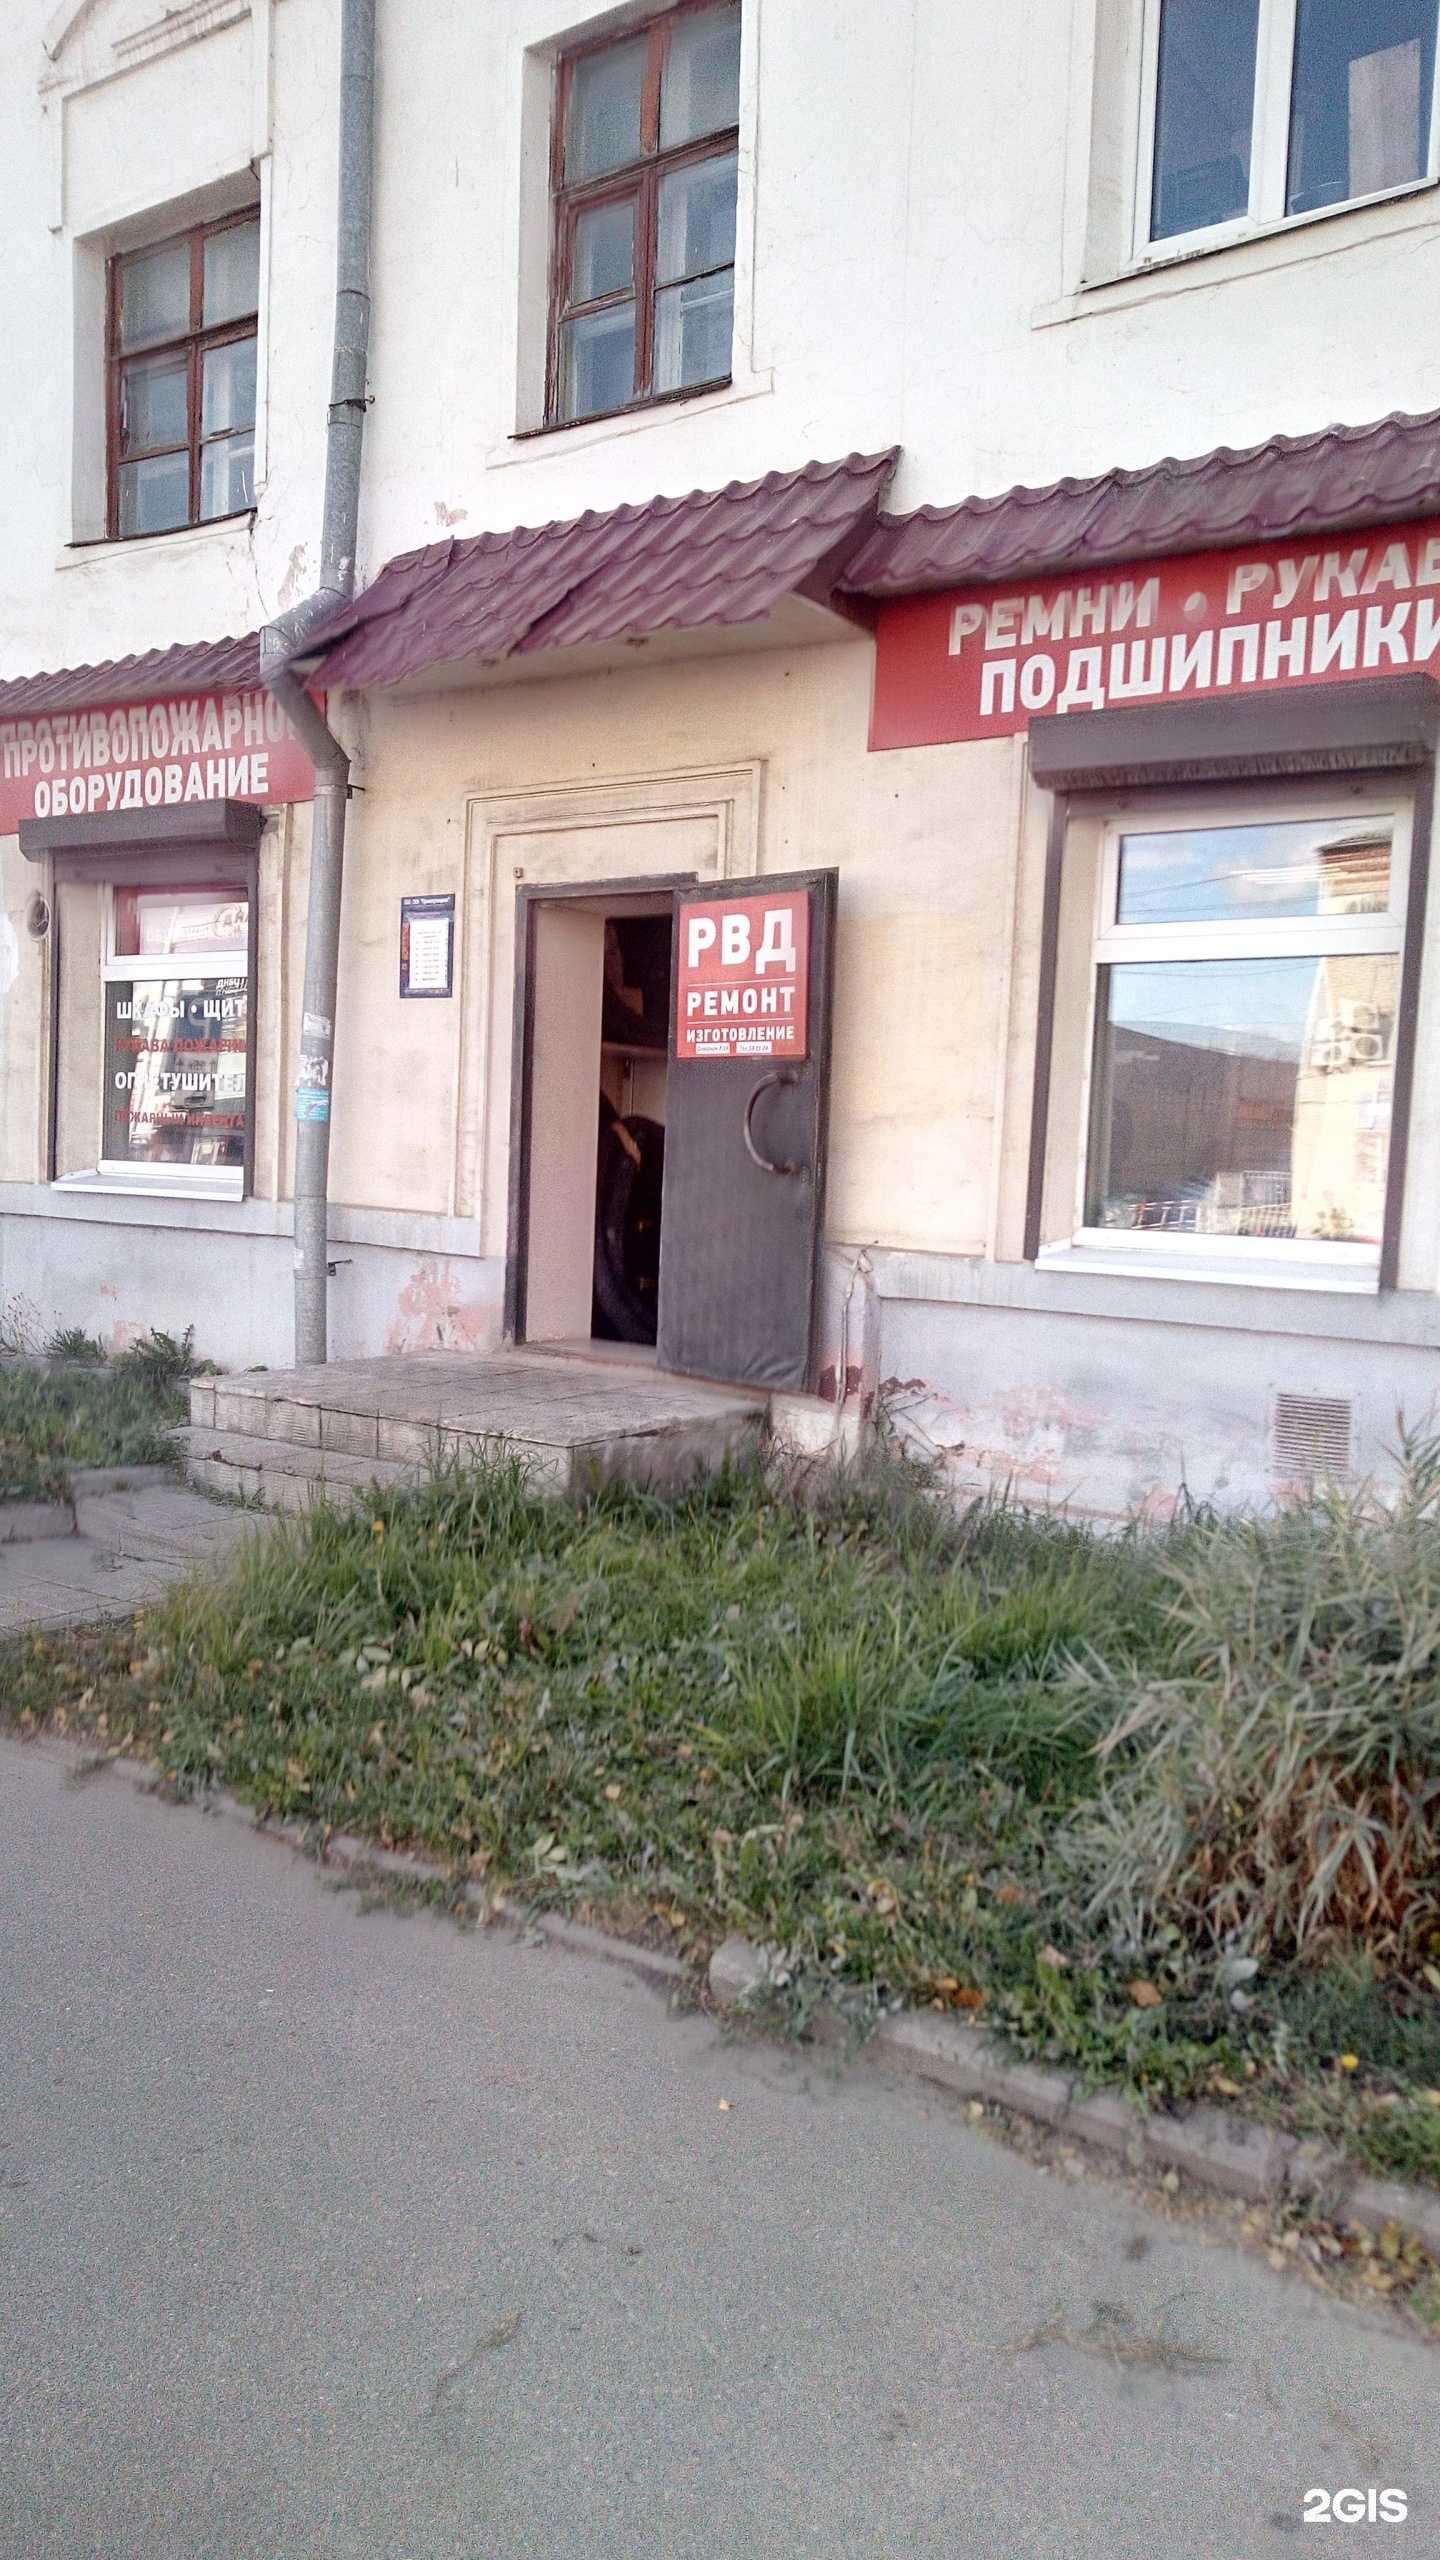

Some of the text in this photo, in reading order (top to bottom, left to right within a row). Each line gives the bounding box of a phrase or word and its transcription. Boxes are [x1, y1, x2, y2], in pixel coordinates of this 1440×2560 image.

[949, 577, 1160, 656] РЕМНИ
[979, 598, 1440, 716] ПОДШИПНИКИ
[3, 692, 298, 778] ПРОТИВОПОЖАРНО
[34, 752, 269, 818] ОБОРУДОВАНИЕ
[688, 908, 796, 974] РВД
[686, 1025, 795, 1042] ИЗГОТОВЛЕНИЕ
[687, 986, 796, 1017] РЕМОНТ
